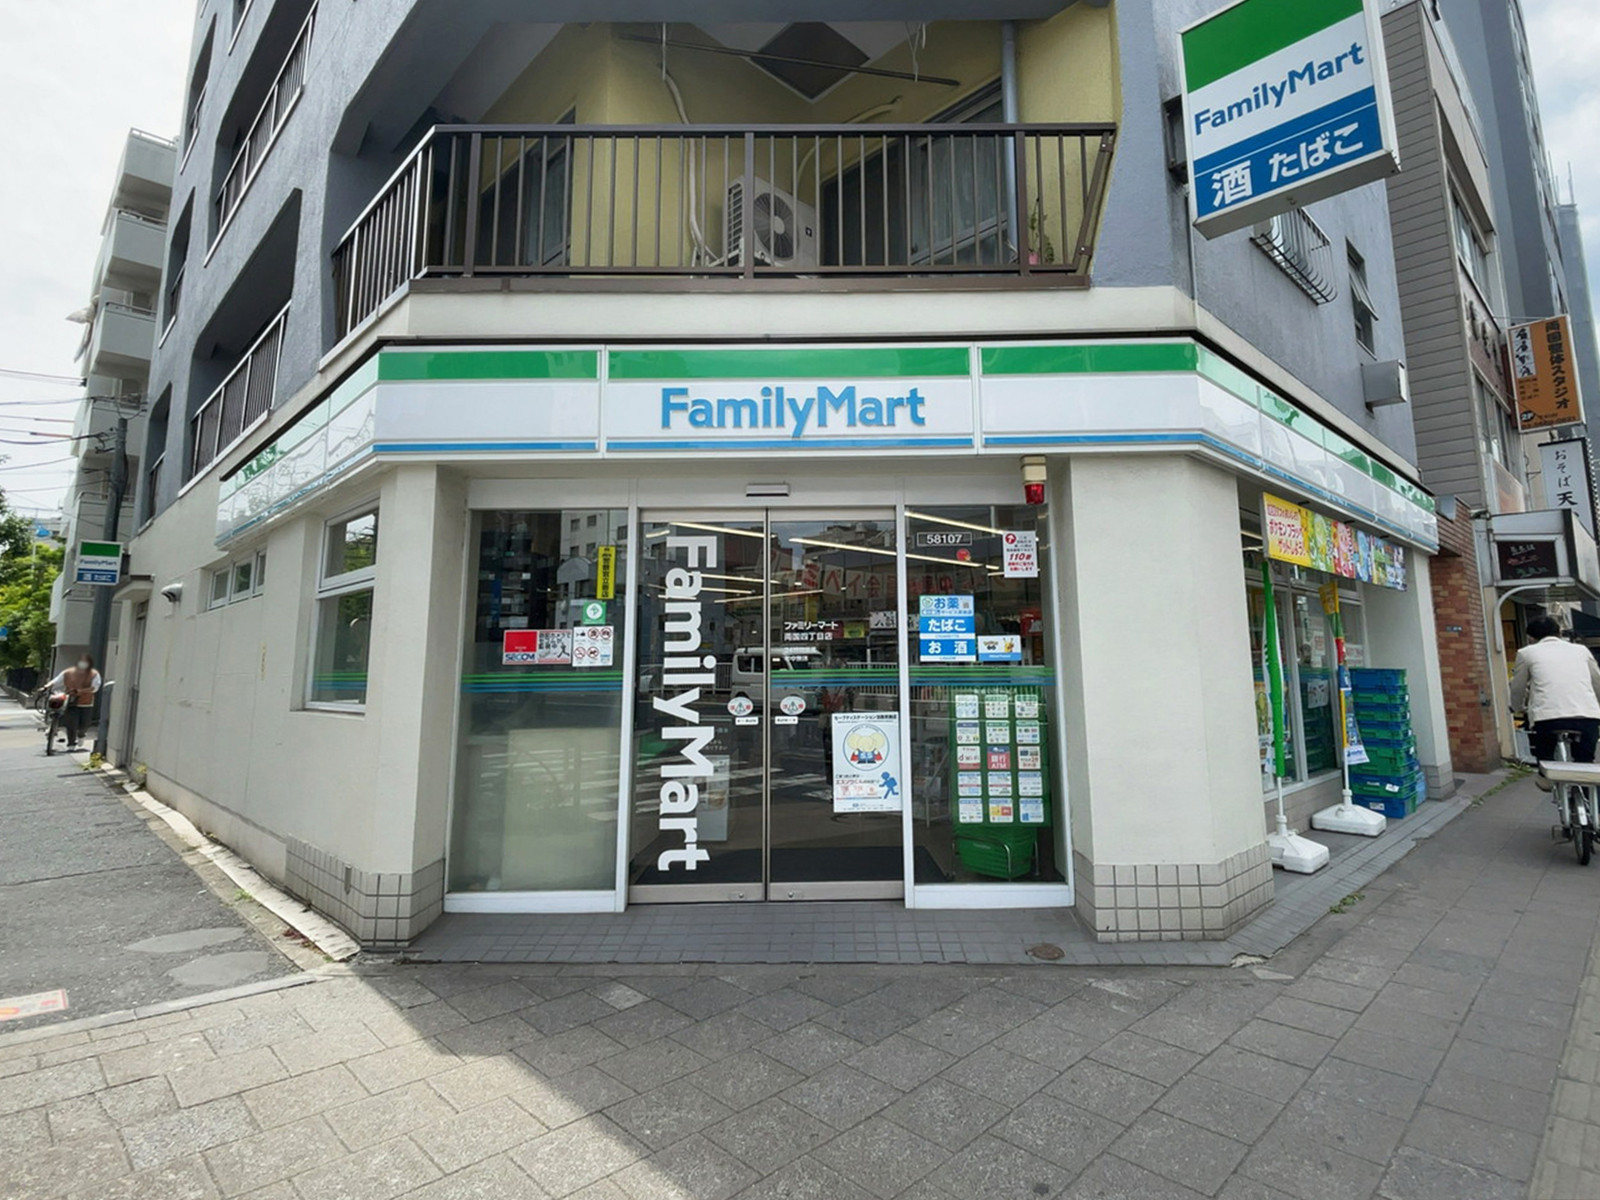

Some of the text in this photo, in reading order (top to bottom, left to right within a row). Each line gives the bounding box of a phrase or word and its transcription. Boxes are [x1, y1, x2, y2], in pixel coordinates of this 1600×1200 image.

[1195, 42, 1364, 135] FamilyMart
[1211, 121, 1364, 208] 酒 たばこ
[661, 386, 926, 438] FamilyMart
[1554, 449, 1579, 518] おそば天
[926, 534, 962, 544] 58107
[934, 597, 960, 609] お薬
[784, 620, 839, 630] ファミリーマート
[928, 618, 967, 632] たばこ
[783, 631, 833, 641] 両国四丁目店
[505, 653, 535, 661] SECOM
[653, 535, 717, 872] FamilyMart
